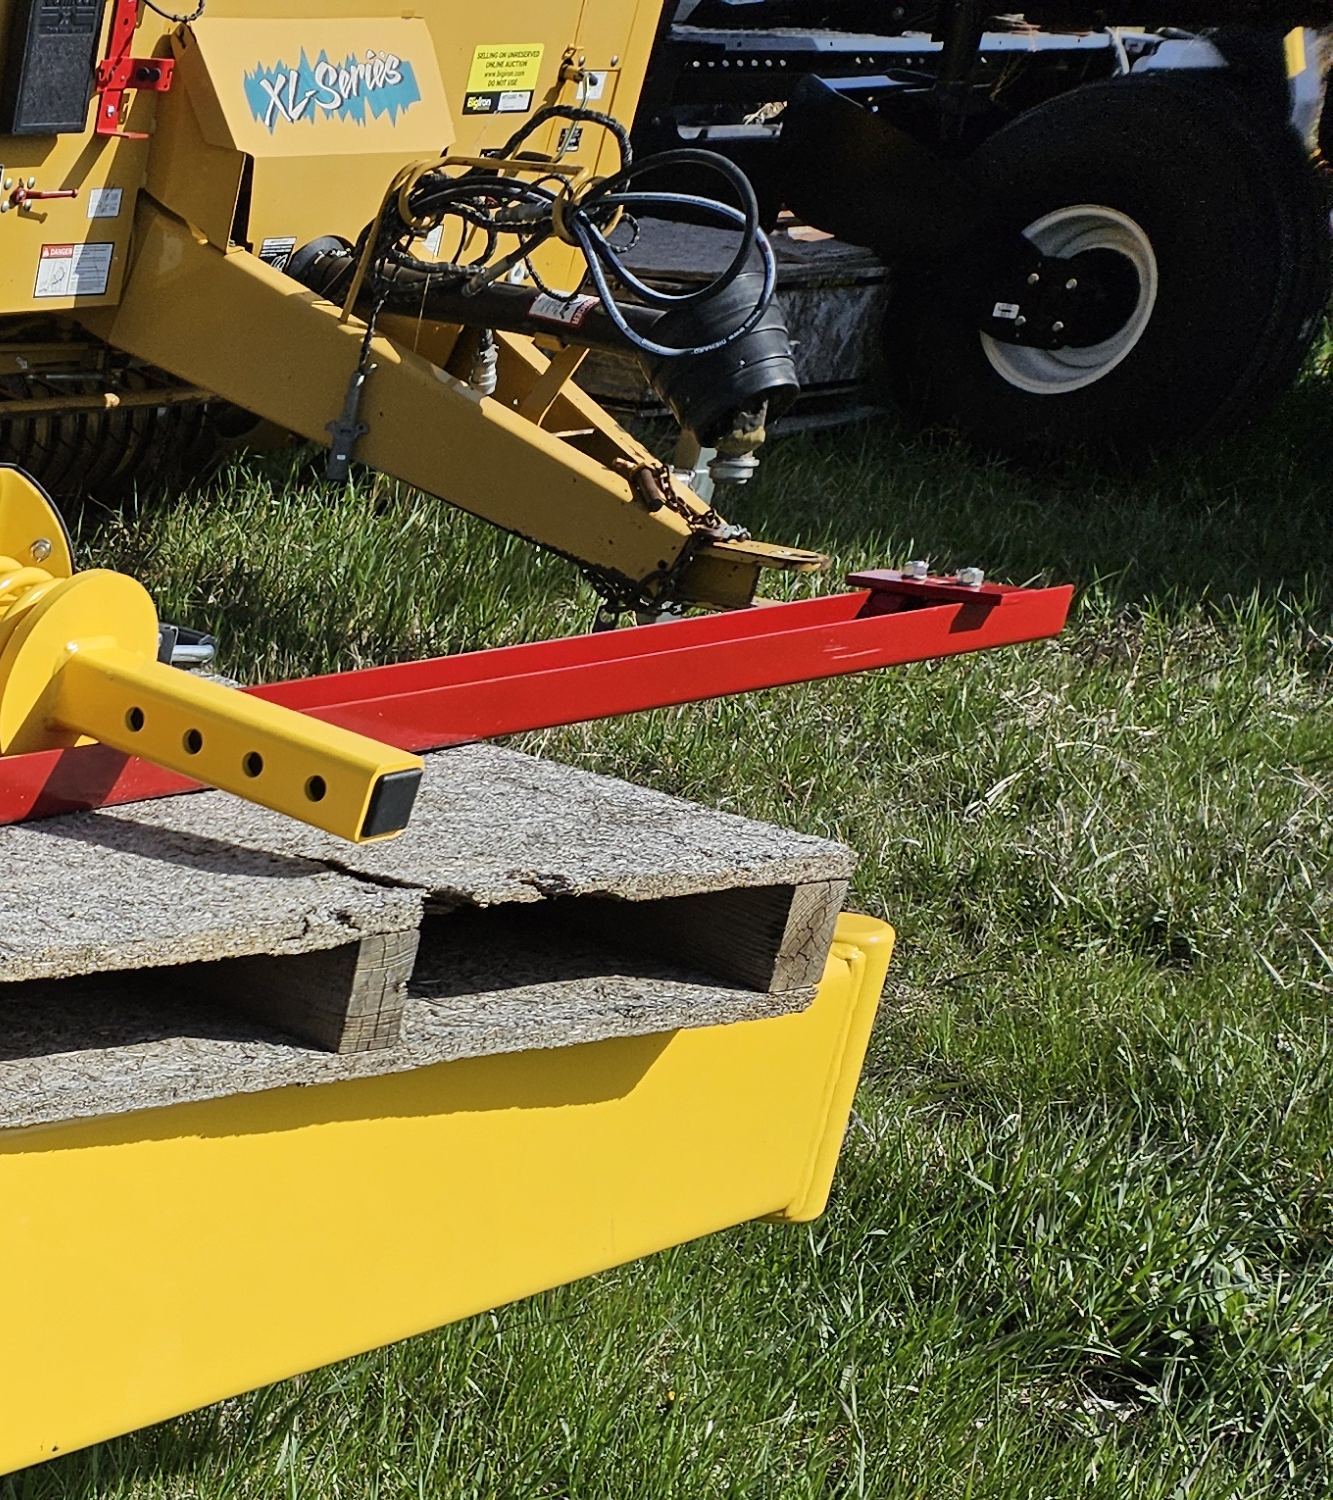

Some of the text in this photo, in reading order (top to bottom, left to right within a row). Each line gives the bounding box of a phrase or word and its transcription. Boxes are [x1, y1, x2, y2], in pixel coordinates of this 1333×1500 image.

[476, 52, 499, 60] SELLING
[507, 50, 541, 59] UNRESERVED
[485, 60, 528, 69] ONLINE AUCTION
[496, 79, 508, 87] NOT
[507, 78, 519, 86] USE
[49, 247, 74, 258] DANGER
